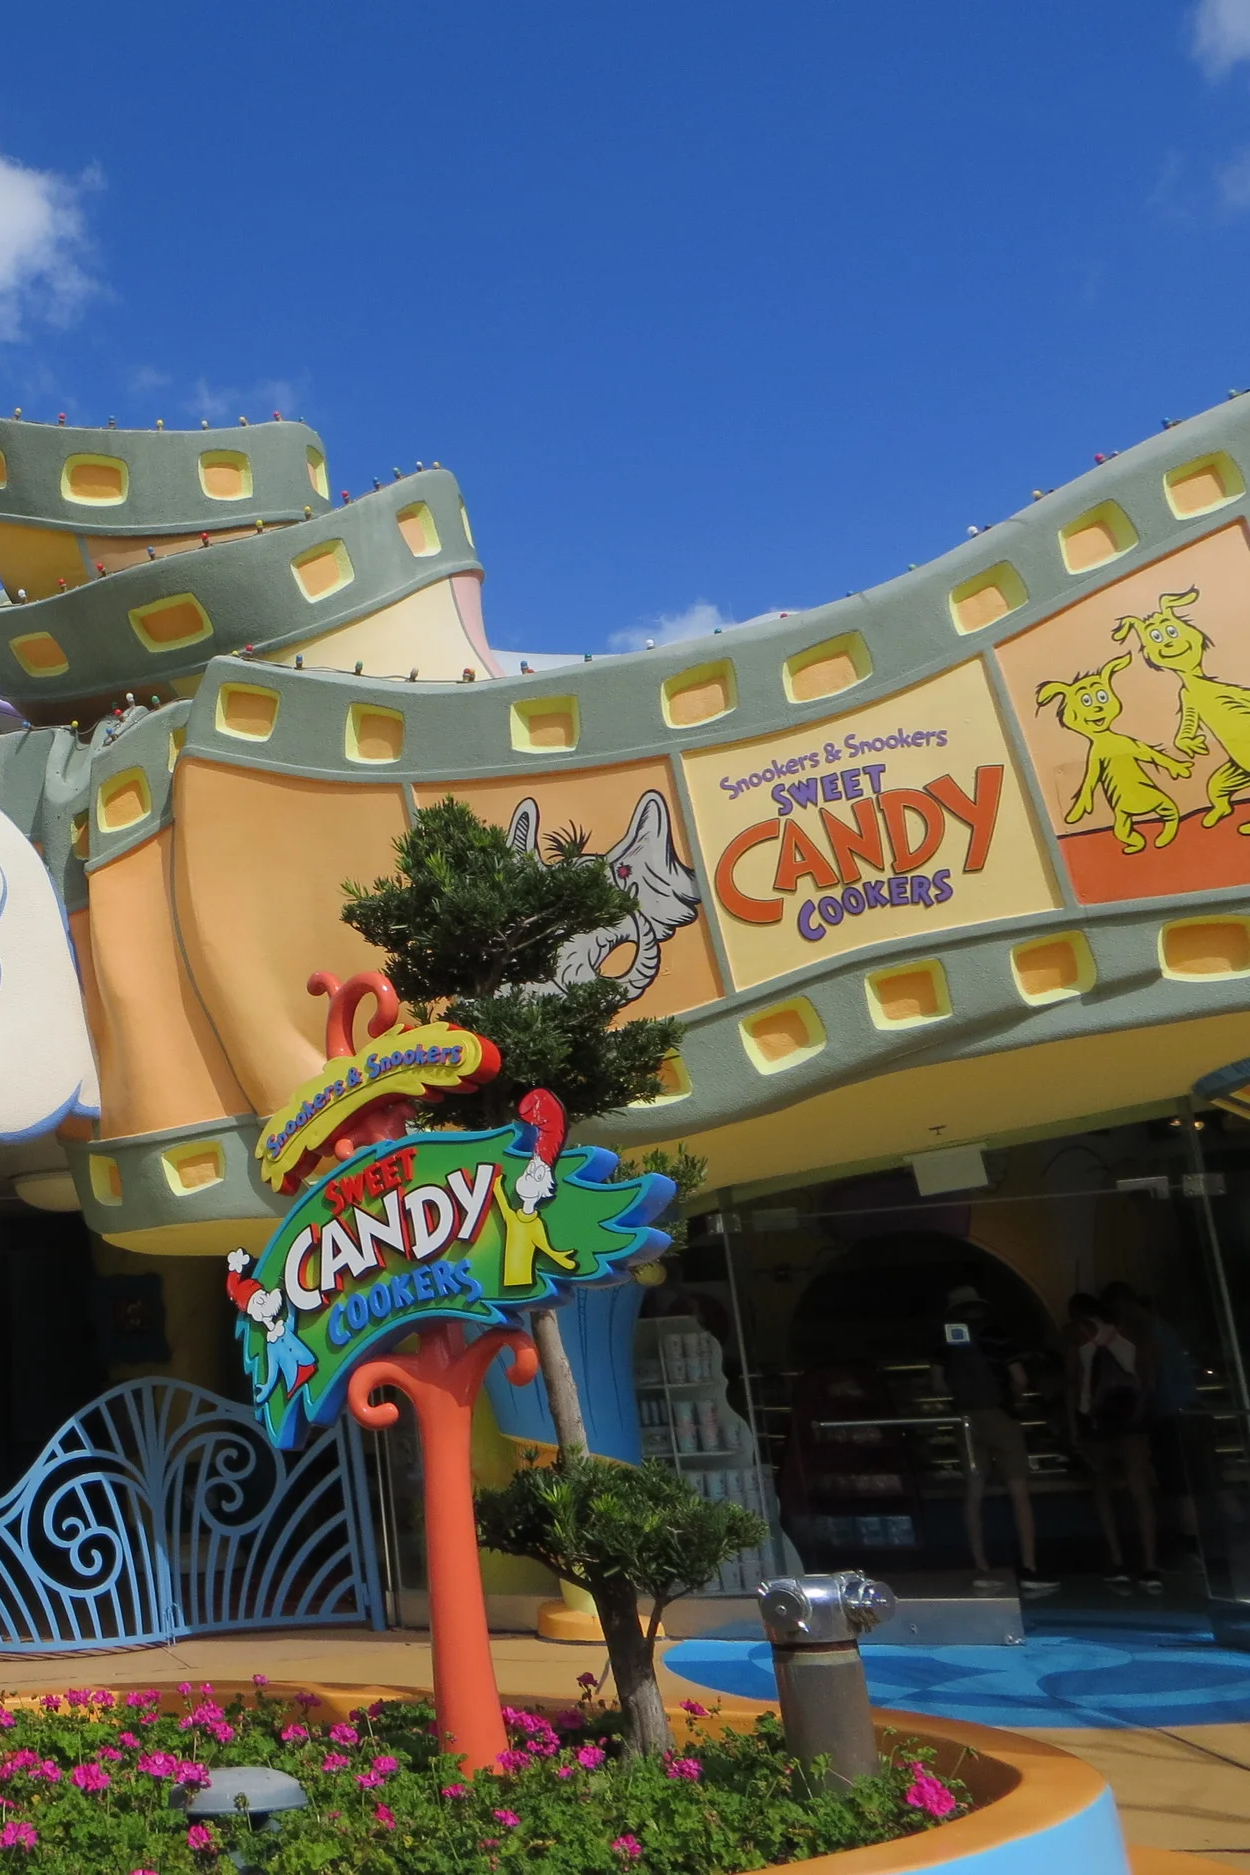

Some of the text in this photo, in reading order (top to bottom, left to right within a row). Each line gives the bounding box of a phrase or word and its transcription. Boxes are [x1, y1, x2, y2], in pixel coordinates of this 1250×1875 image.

[720, 728, 948, 799] Snookers & Snookers
[771, 764, 886, 816] SWEET
[715, 765, 1004, 924] CANDY
[798, 869, 954, 941] COOKERS
[266, 1044, 463, 1158] Snookers & Snookers
[324, 1147, 418, 1216] SWEET
[284, 1162, 500, 1311] CANDY
[328, 1259, 484, 1346] COOKERS
